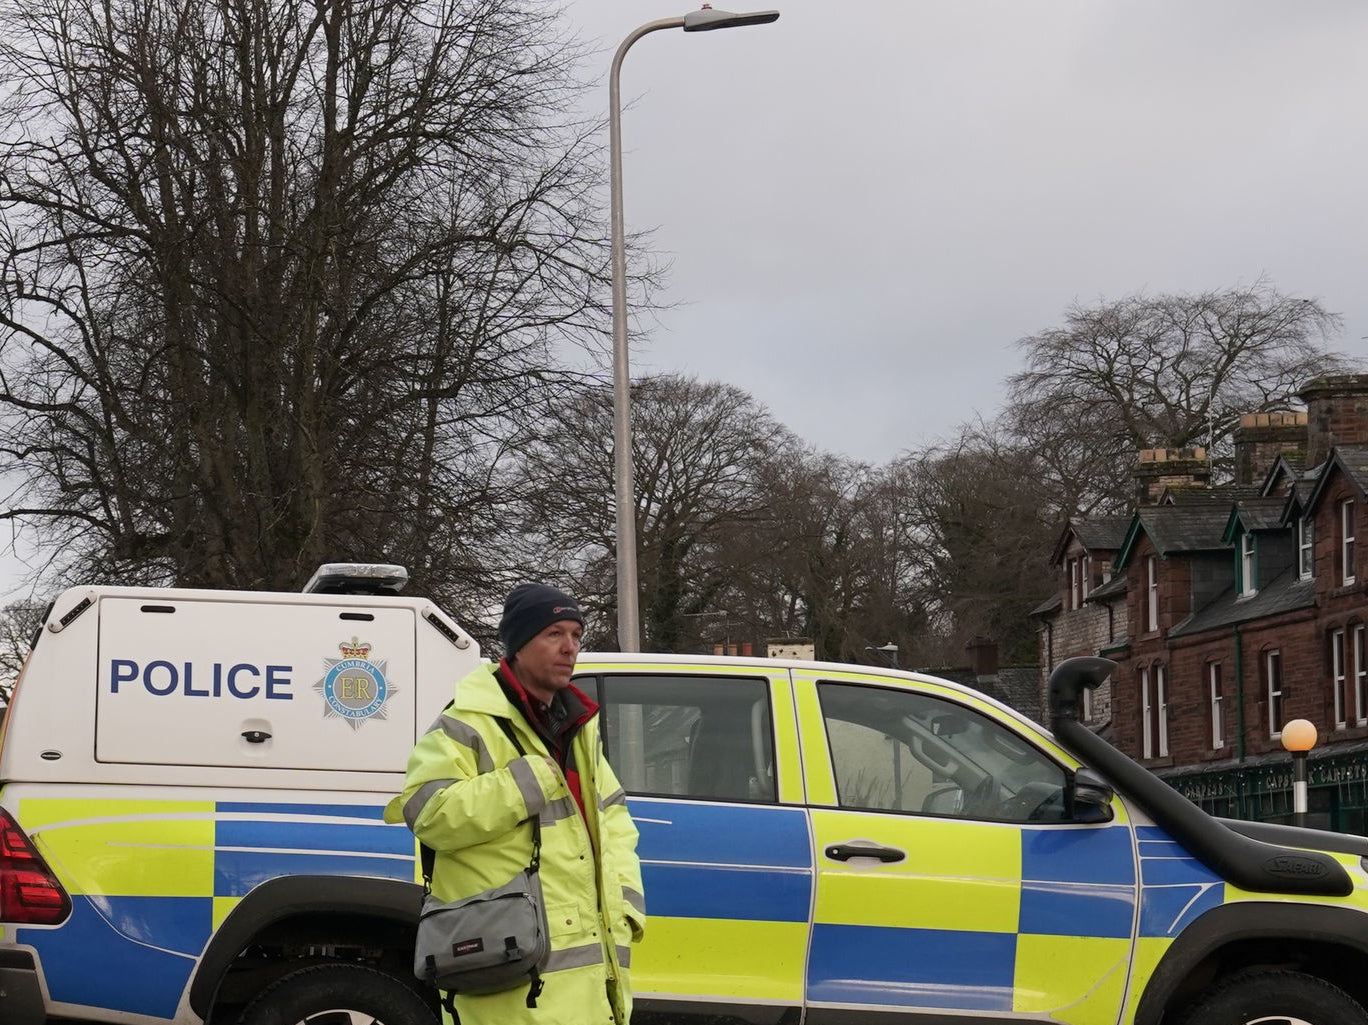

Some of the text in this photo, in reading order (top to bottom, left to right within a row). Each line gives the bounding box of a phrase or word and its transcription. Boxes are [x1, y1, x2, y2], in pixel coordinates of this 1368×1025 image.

[335, 660, 375, 675] CUMBRIA
[110, 659, 293, 700] POLICE
[339, 677, 371, 700] ER
[328, 694, 383, 717] CONSTABULARY
